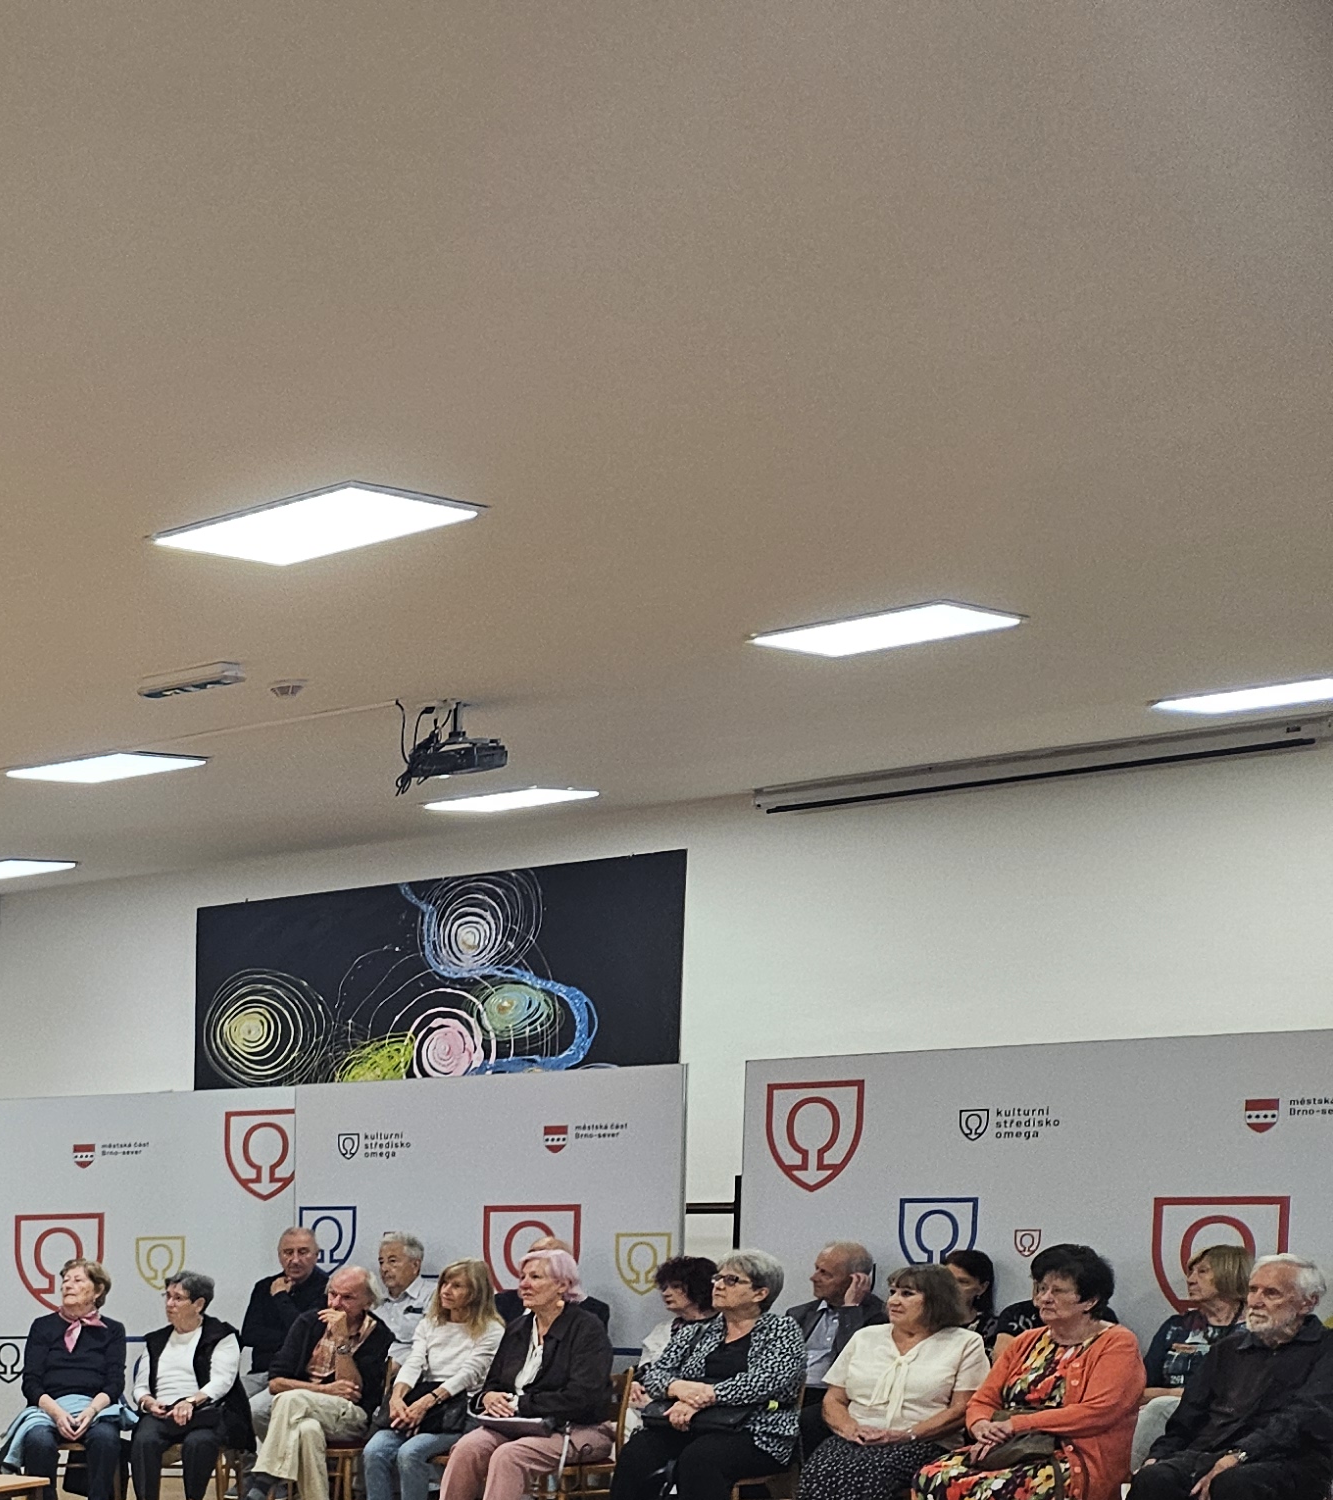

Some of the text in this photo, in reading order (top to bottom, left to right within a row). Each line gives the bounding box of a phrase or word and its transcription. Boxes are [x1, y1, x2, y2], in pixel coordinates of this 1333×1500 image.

[996, 1106, 1050, 1117] kulturní
[995, 1118, 1061, 1128] středisko
[364, 1131, 404, 1140] kulturní
[995, 1130, 1040, 1141] omega
[364, 1141, 412, 1149] středisko
[364, 1150, 396, 1159] omega
